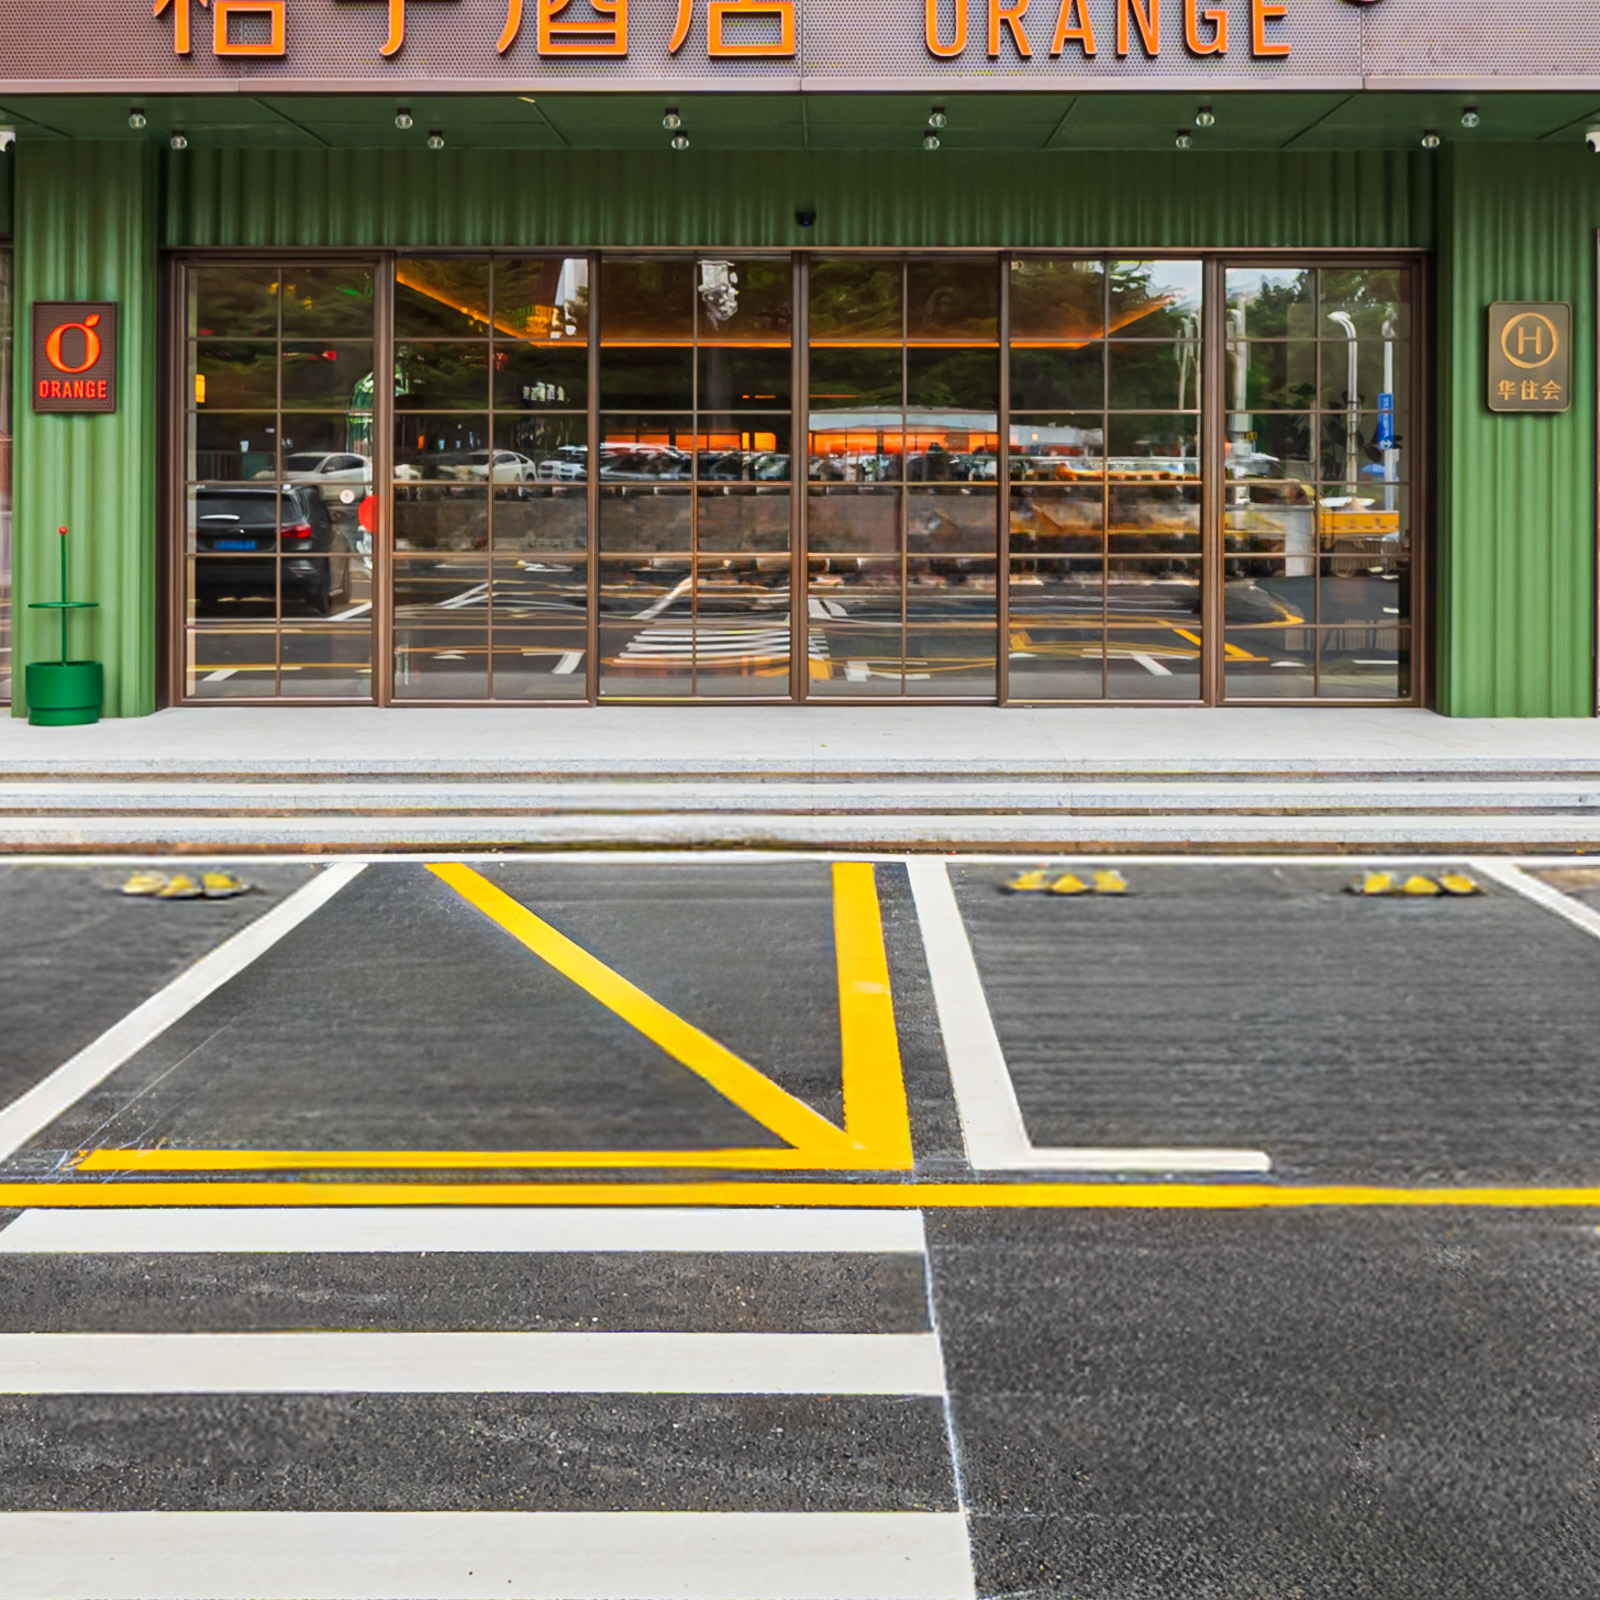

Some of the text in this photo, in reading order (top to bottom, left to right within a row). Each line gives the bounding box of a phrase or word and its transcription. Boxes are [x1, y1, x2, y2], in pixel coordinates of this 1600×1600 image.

[38, 379, 107, 399] ORANGE
[1497, 379, 1562, 401] 华住会
